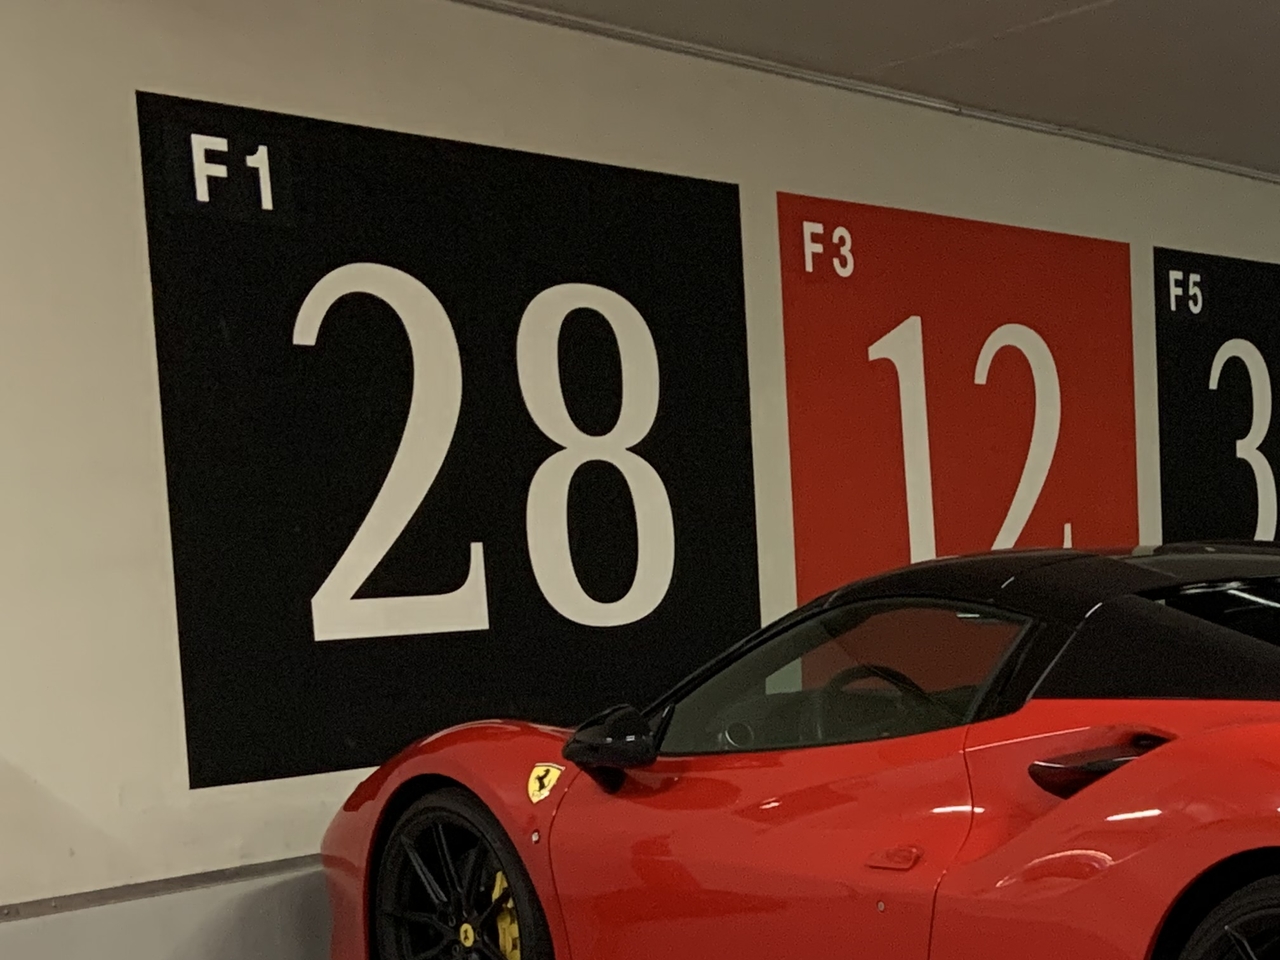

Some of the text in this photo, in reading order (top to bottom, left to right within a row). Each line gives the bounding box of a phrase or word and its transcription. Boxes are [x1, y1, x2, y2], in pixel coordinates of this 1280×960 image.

[190, 133, 274, 211] F1
[803, 220, 855, 278] F3
[1169, 270, 1203, 315] F5
[293, 262, 675, 642] 28
[868, 315, 1074, 563] 12
